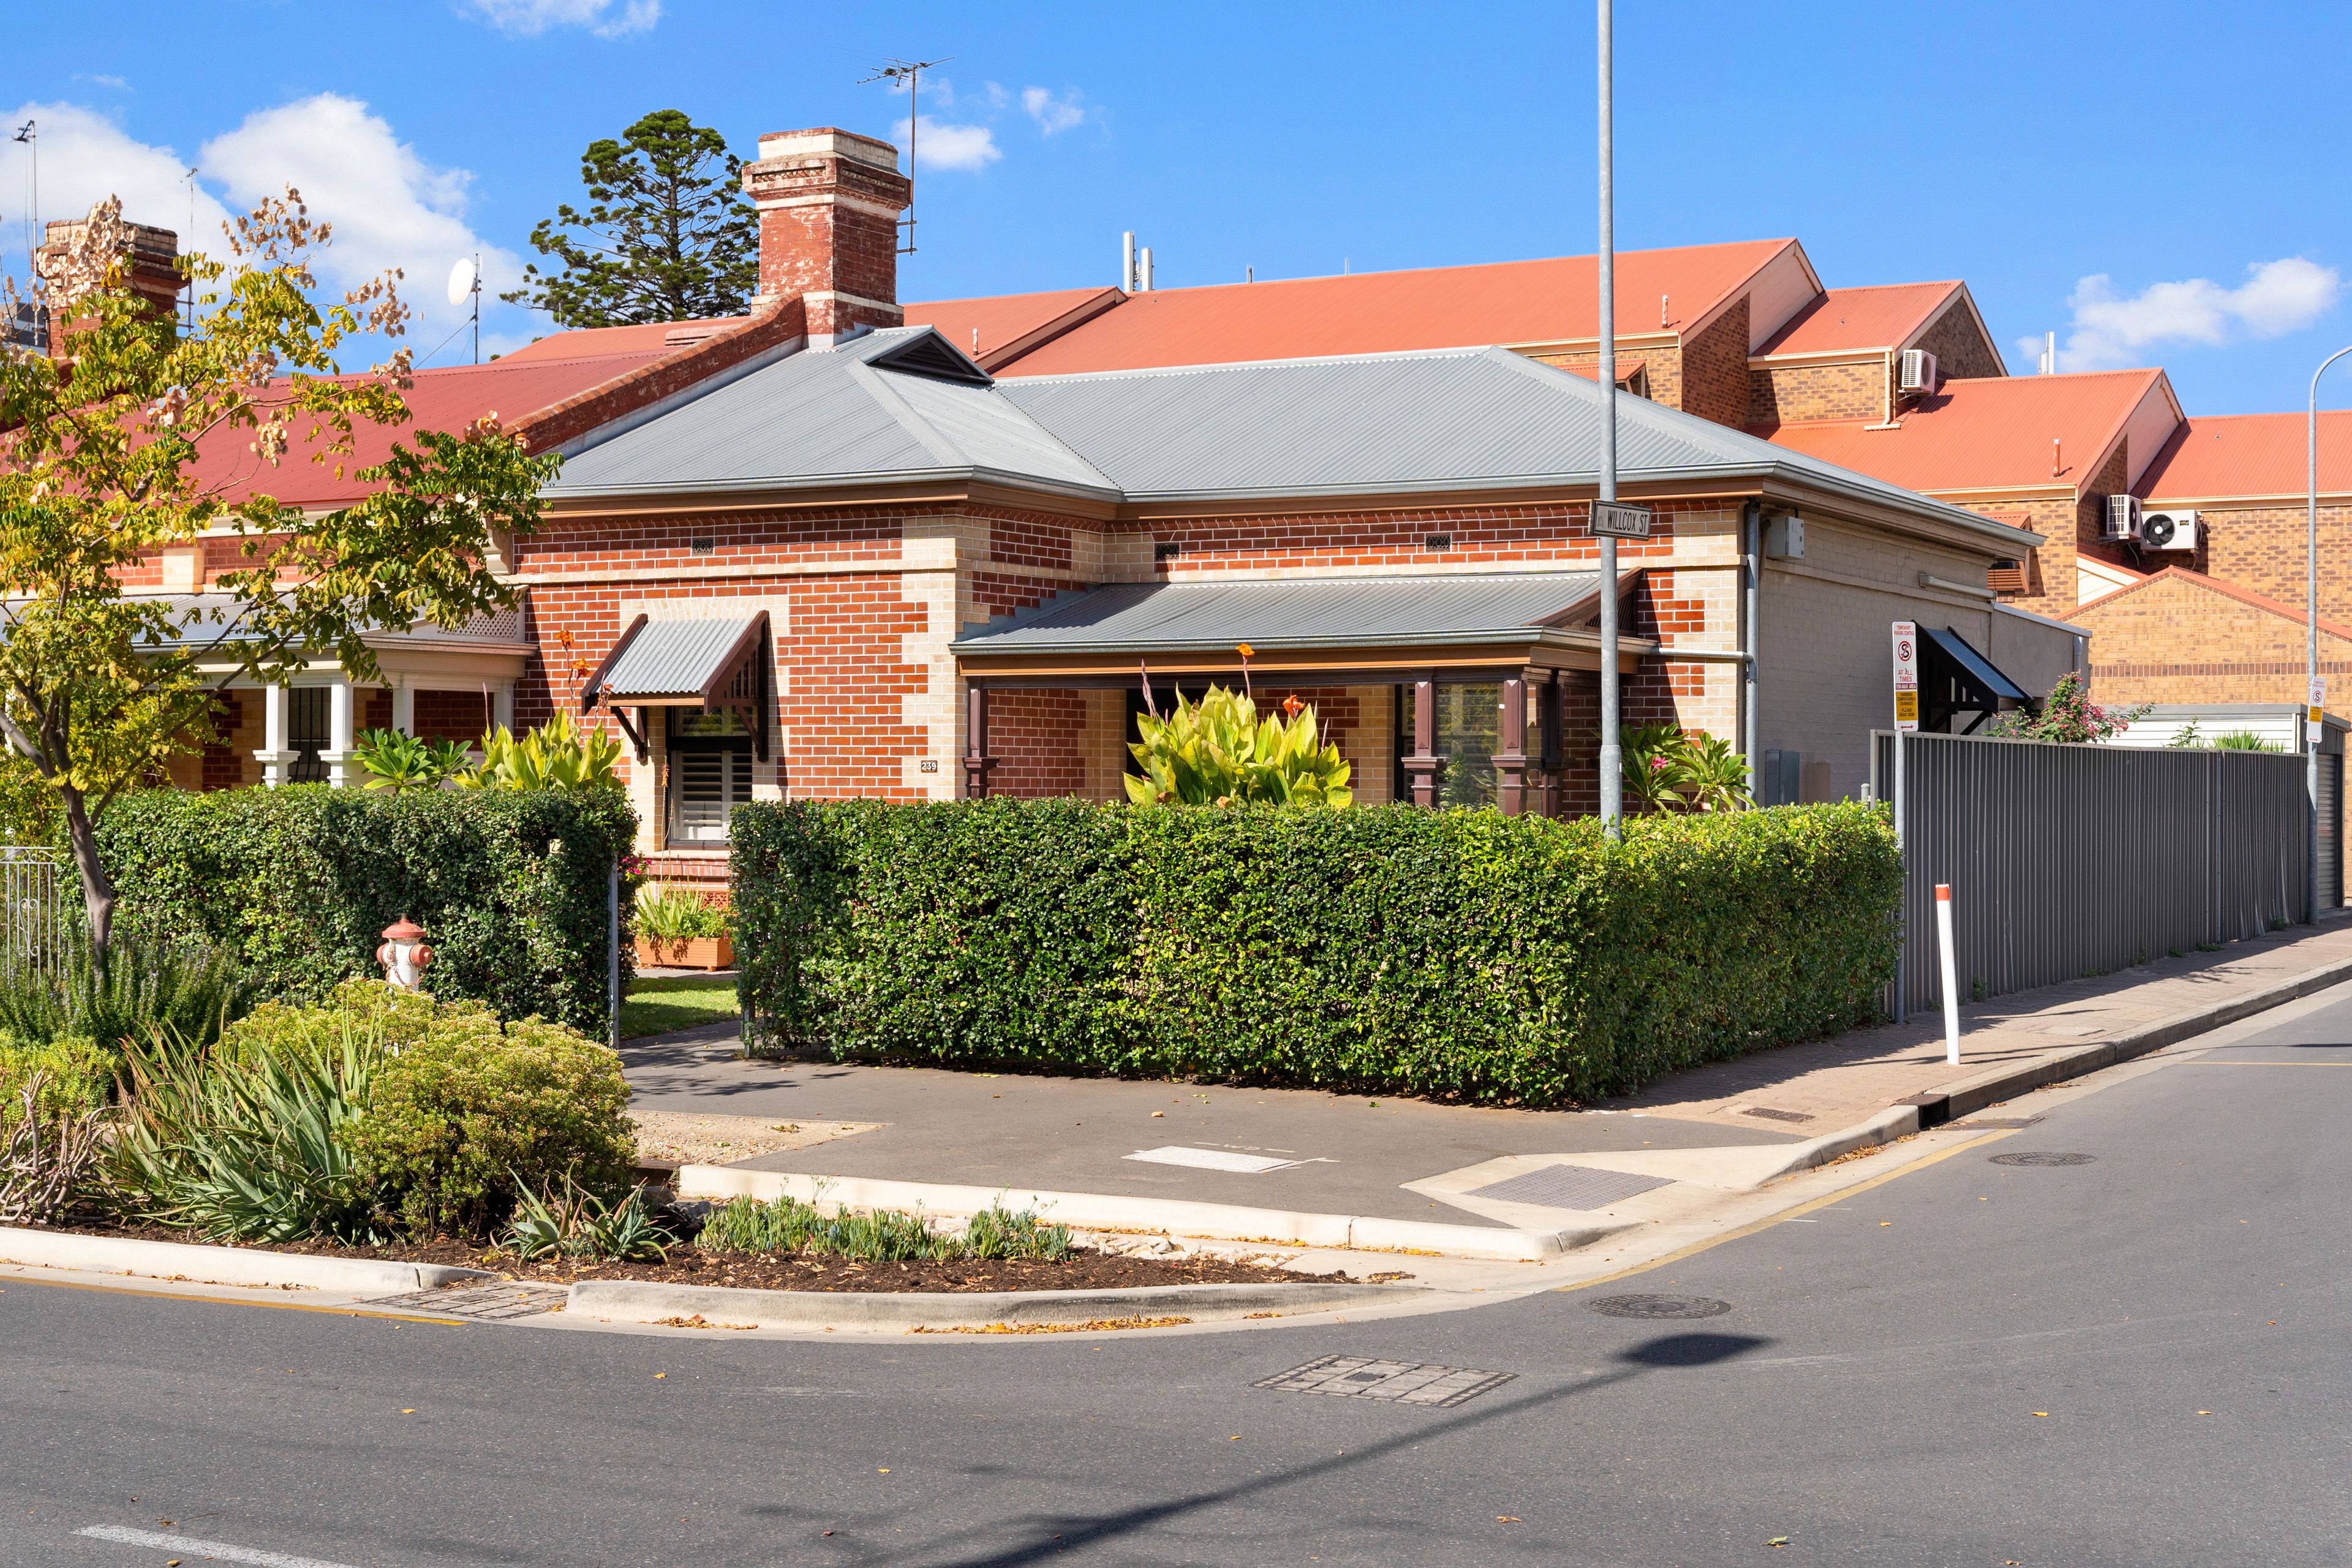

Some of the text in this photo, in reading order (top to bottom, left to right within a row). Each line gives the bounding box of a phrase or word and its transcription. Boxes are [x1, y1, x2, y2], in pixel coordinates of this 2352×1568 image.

[1607, 510, 1648, 533] WILLCOX ST
[921, 762, 937, 771] 239
